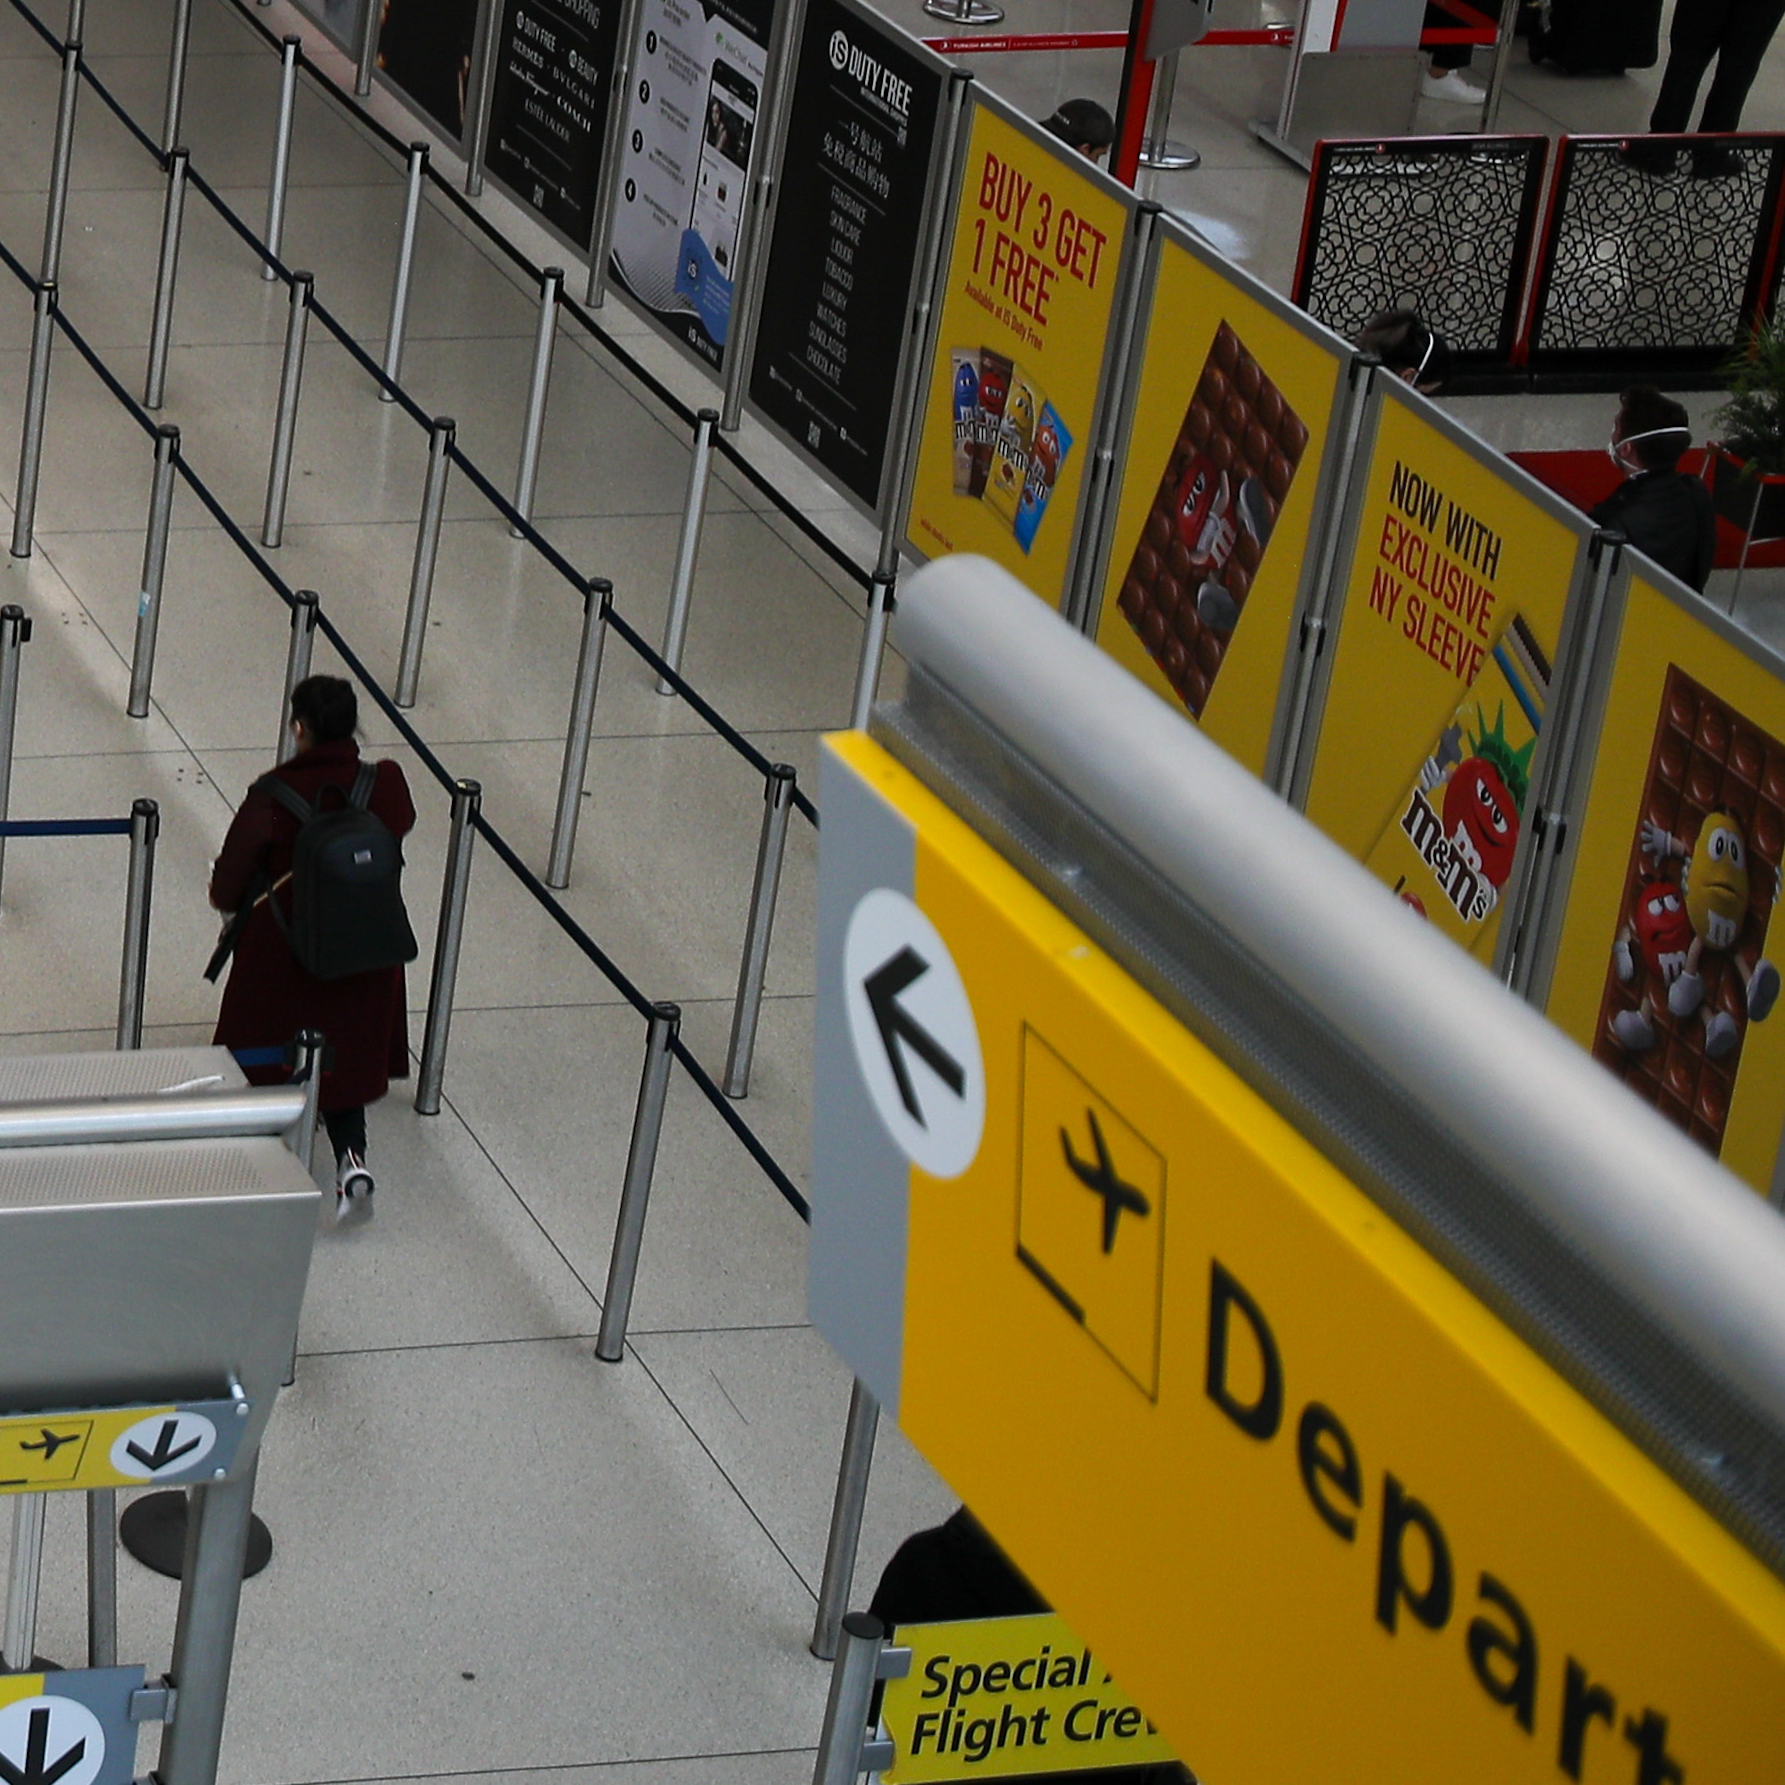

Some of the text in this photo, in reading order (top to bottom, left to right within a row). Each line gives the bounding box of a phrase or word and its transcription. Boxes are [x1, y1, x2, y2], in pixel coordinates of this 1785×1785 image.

[848, 44, 882, 92] DUTY
[880, 65, 913, 117] FREE
[973, 218, 986, 274] 1
[979, 152, 1107, 289] BUY 3 GET
[824, 255, 854, 292] TOBACCO
[1390, 461, 1502, 581] NOW WITH
[1379, 515, 1496, 641] EXCLUSIVE
[1369, 565, 1485, 688] NY SLEEVE
[920, 1648, 1092, 1703] Special
[910, 1705, 1048, 1762] Flight
